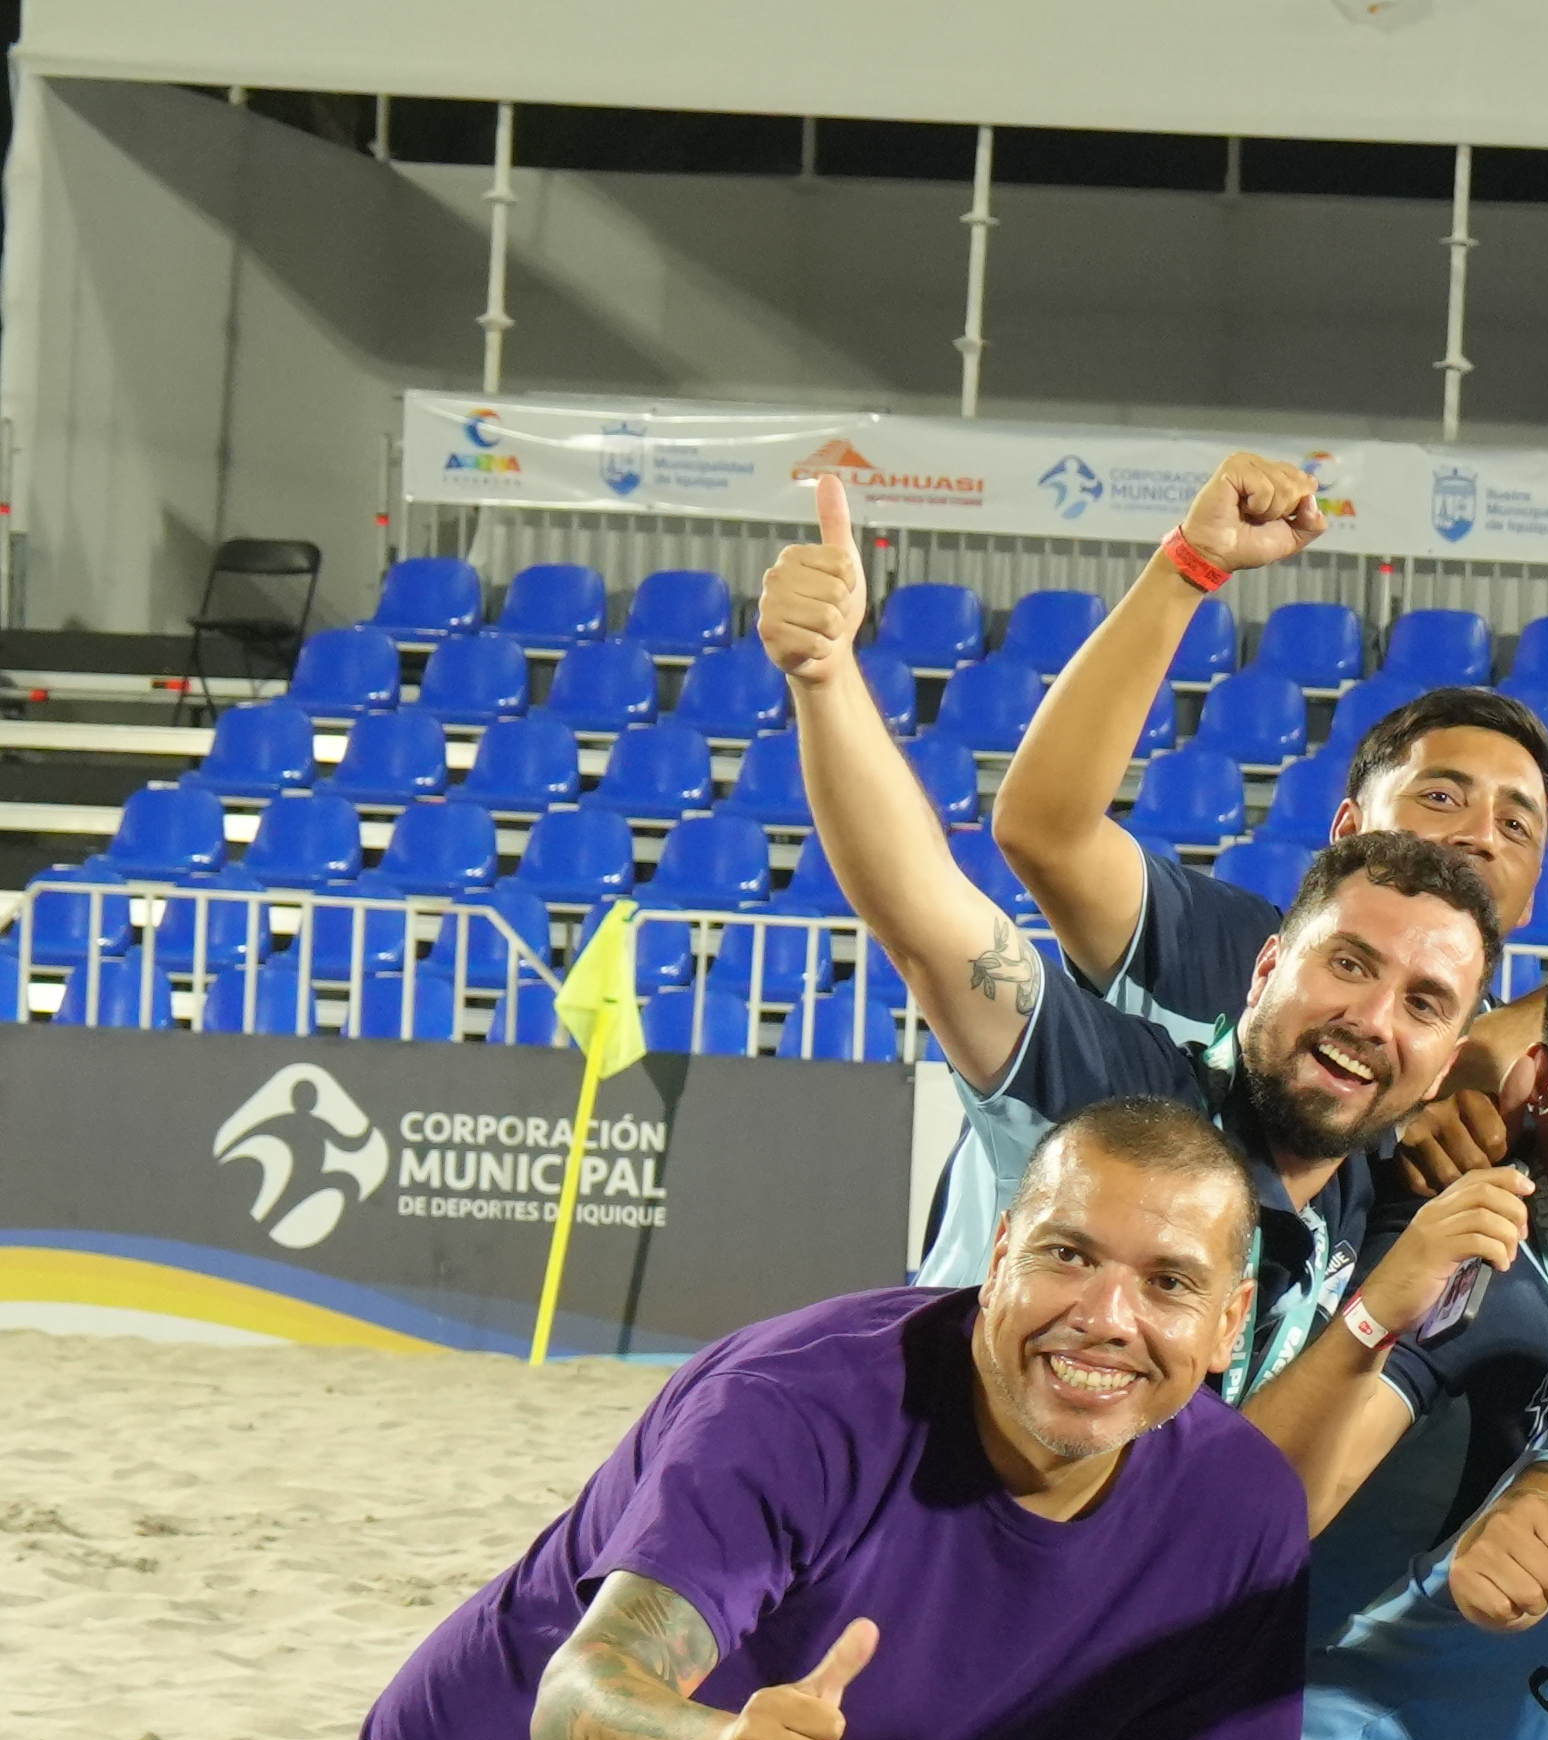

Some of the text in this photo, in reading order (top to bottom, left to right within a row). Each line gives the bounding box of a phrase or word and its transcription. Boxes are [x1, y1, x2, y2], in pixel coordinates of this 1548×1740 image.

[1110, 484, 1199, 501] MUNICIP
[399, 1110, 667, 1153] CORPORACIÓN
[398, 1147, 667, 1198] MUNICPAL
[397, 1194, 667, 1228] DE DEPORTES D IQUIQUE
